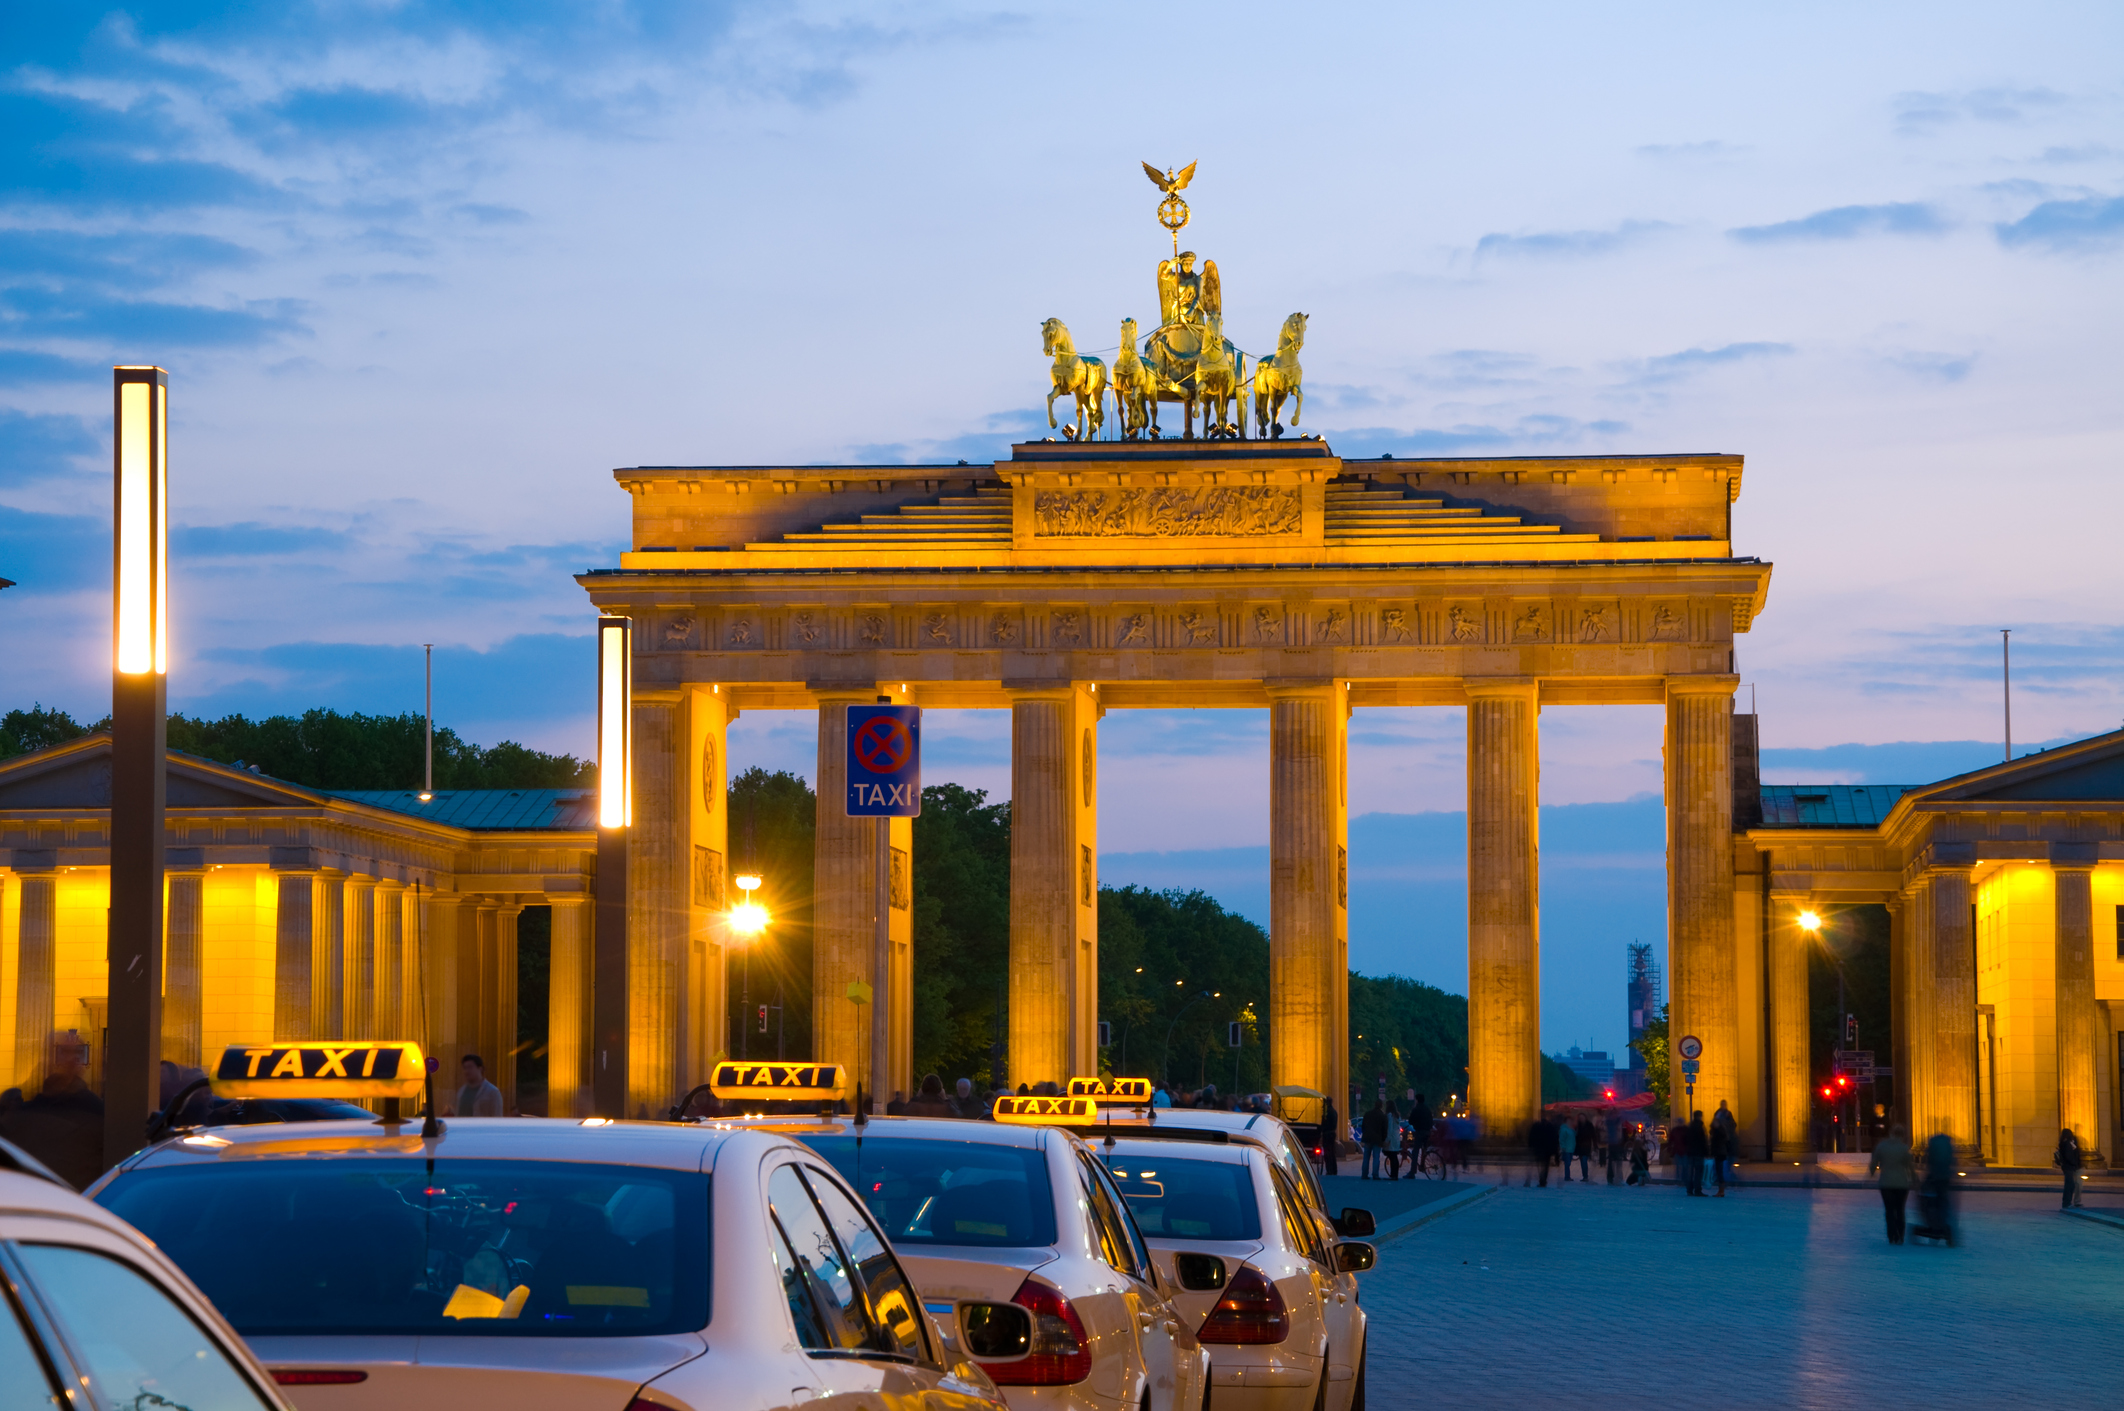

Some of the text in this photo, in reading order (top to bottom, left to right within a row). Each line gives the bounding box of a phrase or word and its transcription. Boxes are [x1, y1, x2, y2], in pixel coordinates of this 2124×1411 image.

[853, 783, 912, 806] TAXI
[244, 1048, 379, 1078] TAXI
[733, 1066, 820, 1087] TAXI
[1080, 1081, 1136, 1095] TAXI
[1010, 1099, 1076, 1114] TAXI
